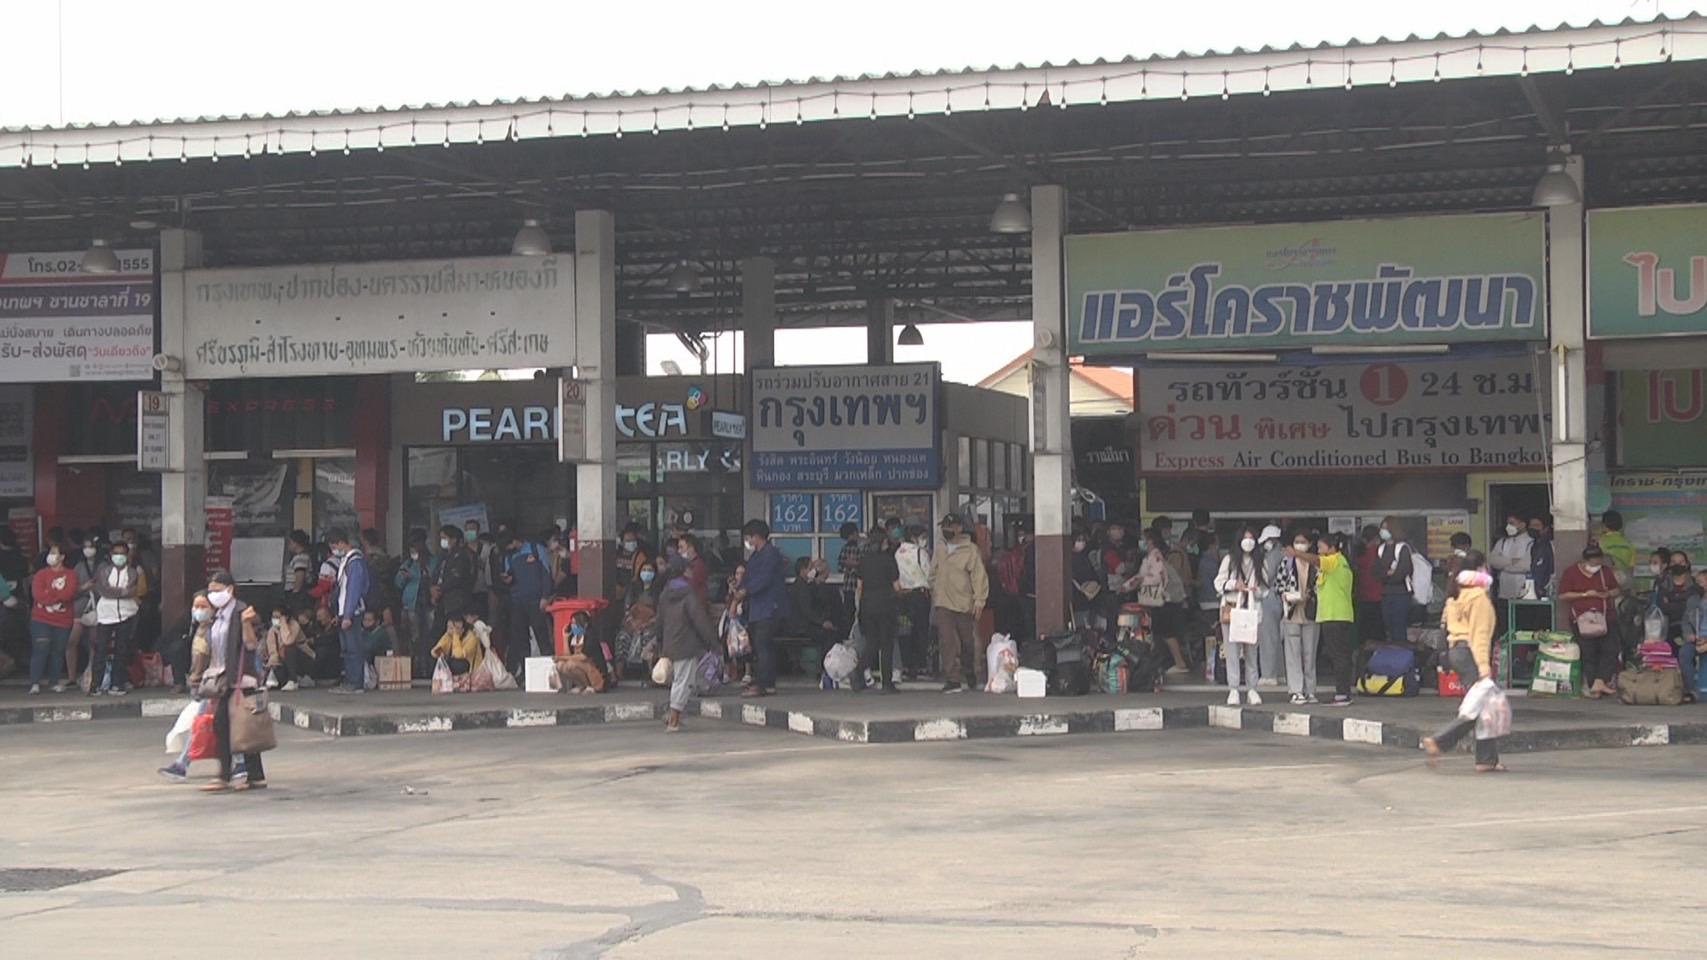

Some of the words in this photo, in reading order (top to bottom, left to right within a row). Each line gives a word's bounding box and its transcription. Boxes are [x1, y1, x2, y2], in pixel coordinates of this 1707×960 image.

[50, 286, 130, 309] ชานชาลาที่
[135, 293, 151, 307] 19
[1079, 263, 1535, 342] แอร์โคราชพัฒนา
[566, 383, 580, 400] 20
[756, 371, 909, 391] รถร่วมปรับอากาศสาย
[914, 372, 929, 386] 21
[1168, 366, 1347, 403] รถทัวร์ชั้น
[1421, 371, 1461, 396] 24
[148, 395, 160, 412] 19
[759, 393, 927, 447] กรุงเทพฯ
[1147, 404, 1241, 441] ด่วน
[1254, 417, 1332, 441] พิเศษ
[1155, 451, 1224, 471] Express
[1233, 450, 1263, 468] Air
[1270, 449, 1387, 467] Conditioned
[1397, 449, 1431, 465] Bus
[1441, 451, 1459, 465] to
[774, 504, 809, 522] 162
[823, 504, 859, 522] 162
